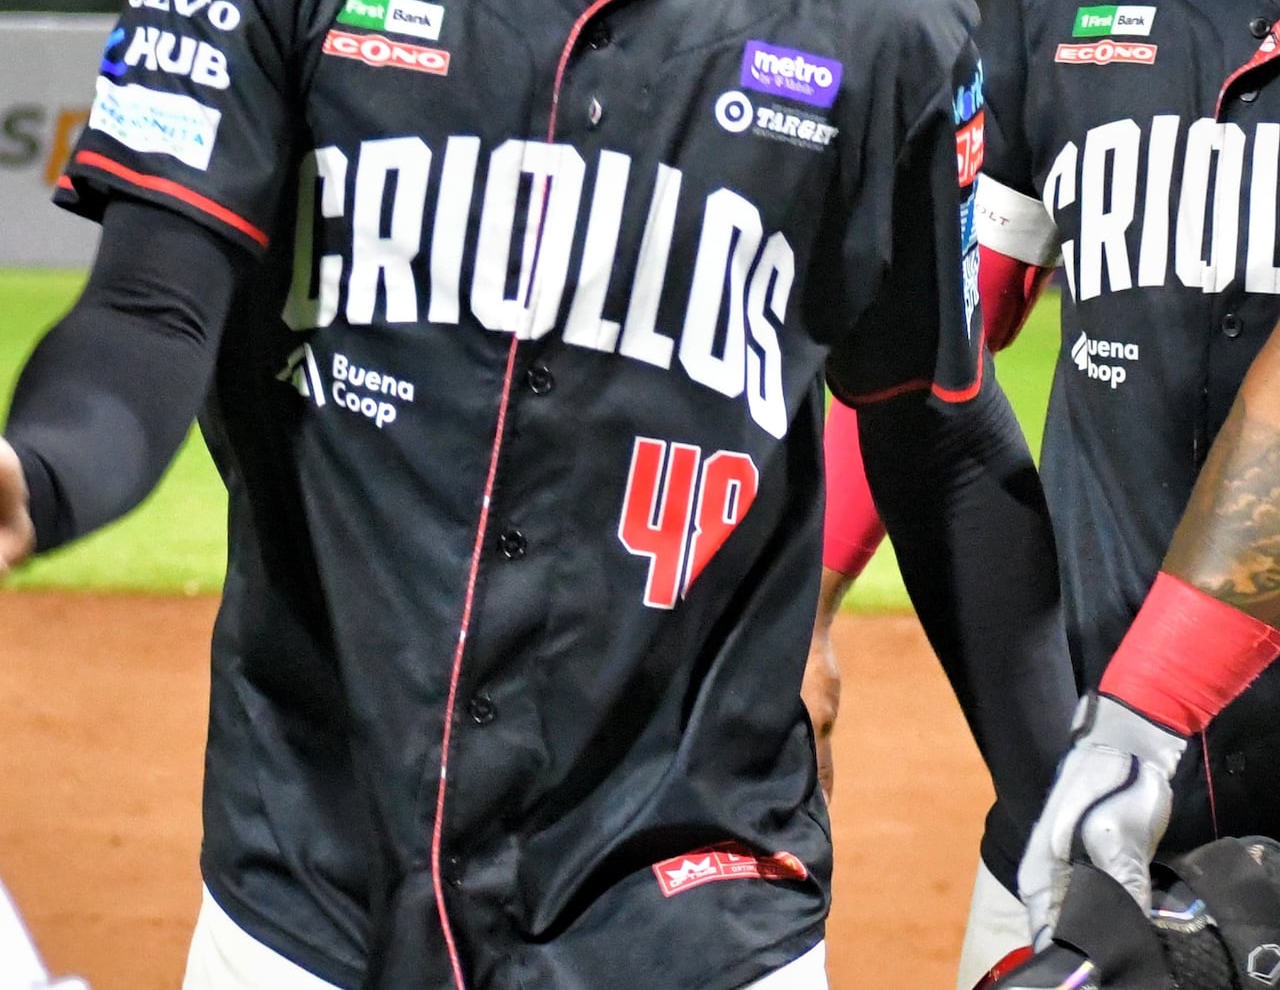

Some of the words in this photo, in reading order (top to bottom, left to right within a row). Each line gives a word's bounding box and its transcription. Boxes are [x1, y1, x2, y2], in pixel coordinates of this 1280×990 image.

[393, 8, 431, 27] Bank
[124, 26, 231, 90] HUB
[754, 50, 832, 88] metro
[1060, 44, 1153, 61] ECONO
[757, 107, 839, 145] TARGET
[282, 136, 794, 440] CRIOLLOS
[332, 353, 415, 402] Buena
[332, 381, 397, 428] Coop
